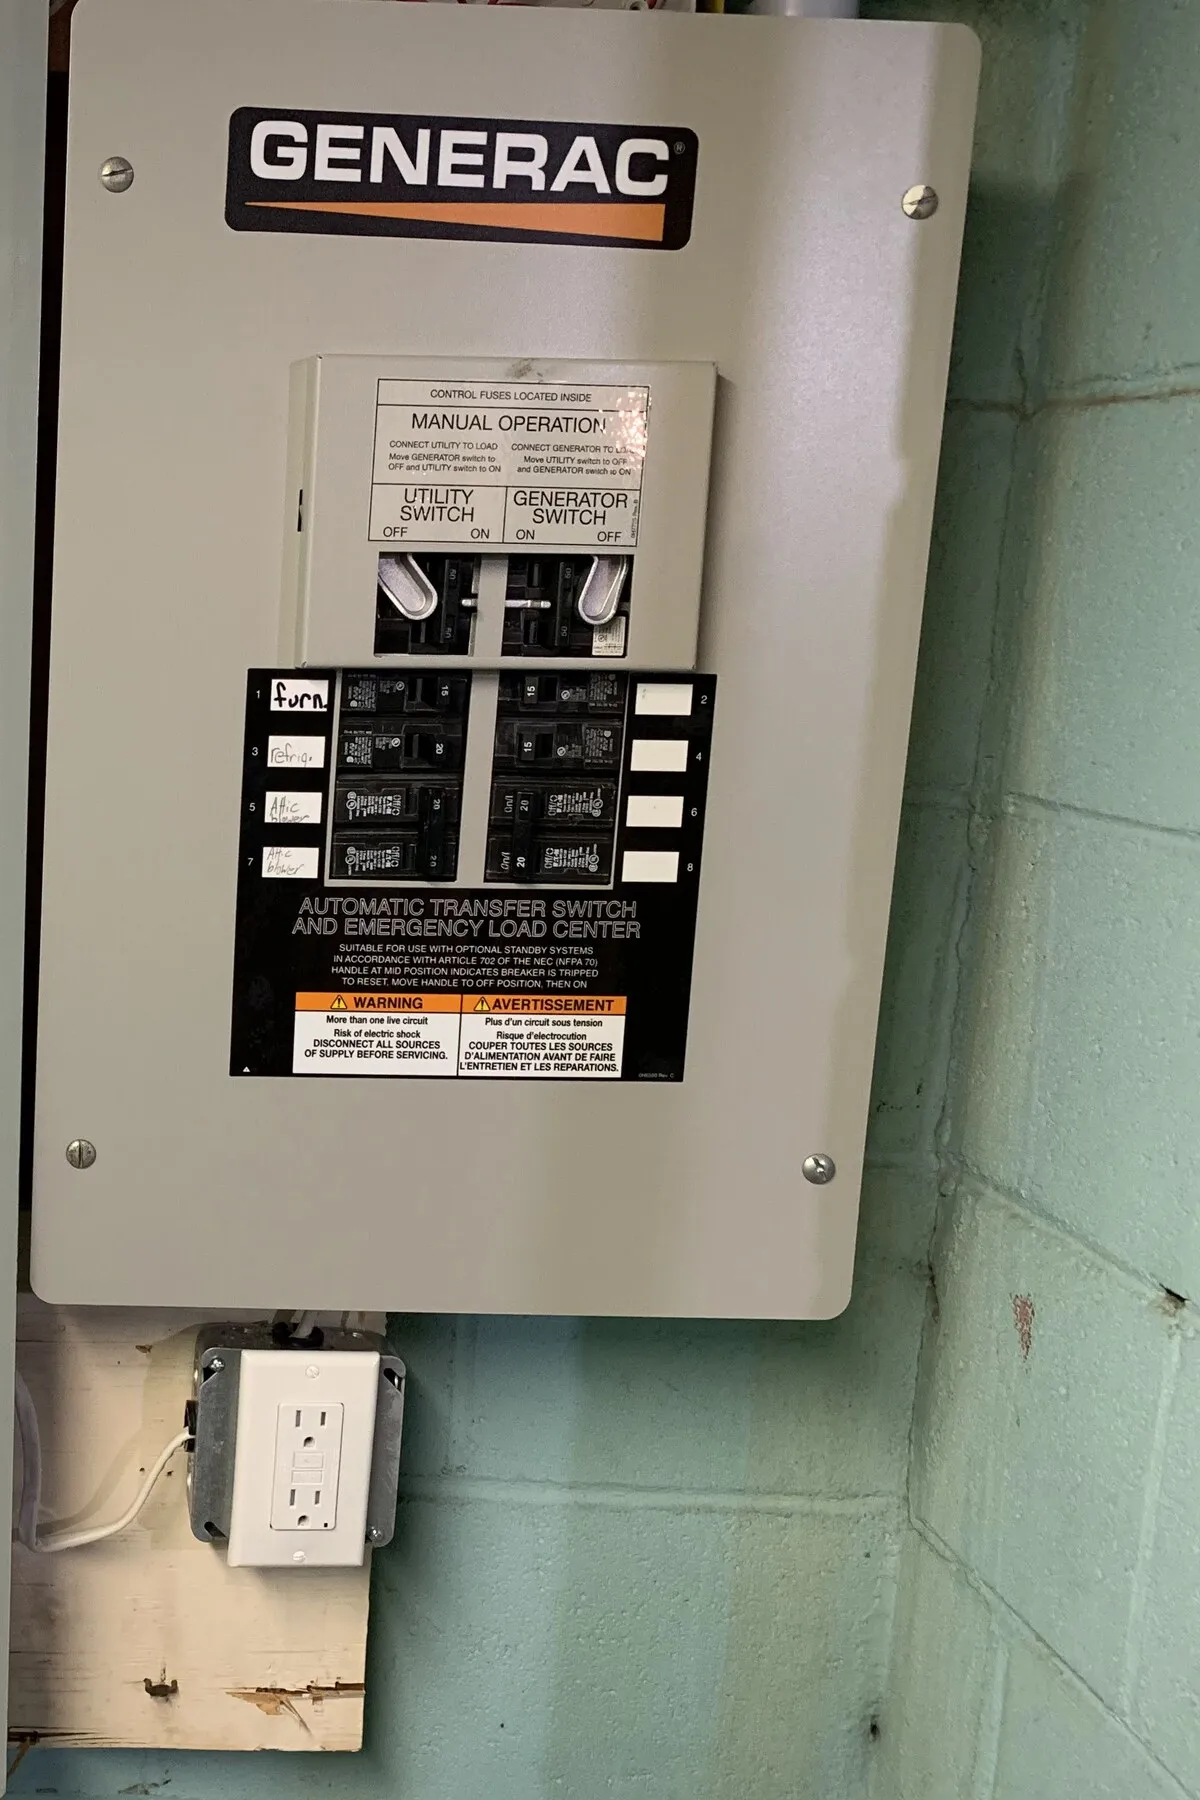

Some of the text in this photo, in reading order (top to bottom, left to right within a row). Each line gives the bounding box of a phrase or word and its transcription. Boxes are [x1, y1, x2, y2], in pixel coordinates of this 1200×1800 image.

[250, 120, 669, 196] GENERAC
[431, 390, 592, 402] CONTROL FUSES LOCATED INSIDE
[412, 413, 606, 434] MANUAL OPERATION
[390, 441, 429, 449] CONNECT
[476, 442, 498, 450] LOAD
[411, 454, 460, 462] GENERATOR
[524, 456, 544, 464] Move
[388, 463, 404, 471] OFF
[406, 463, 420, 471] and
[453, 464, 476, 472] switch
[533, 466, 583, 474] GENERATOR
[585, 467, 608, 475] switch
[404, 488, 473, 505] UTILITY
[514, 491, 628, 508] GENERATOR
[400, 506, 474, 522] SWITCH
[532, 509, 606, 525] SWITCH
[383, 527, 408, 537] OFF
[471, 529, 489, 539] ON
[516, 530, 535, 540] ON
[597, 532, 621, 542] OFF
[441, 686, 448, 696] 15
[527, 686, 535, 697] 15
[701, 696, 707, 704] 2
[252, 747, 258, 755] 3
[436, 744, 443, 754] 20
[524, 742, 532, 752] 15
[249, 803, 255, 811] 5
[521, 800, 529, 811] 20
[691, 808, 697, 816] 6
[248, 858, 254, 866] 7
[517, 857, 525, 868] 20
[299, 898, 636, 918] AUTOMATIC TRANSFER SWITCH
[292, 918, 641, 939] AND EMERGENCY LOAD CENTER
[339, 944, 383, 952] SUITABLE
[455, 946, 502, 954] OPTIONAL
[504, 946, 547, 955] STANDBY
[549, 947, 593, 955] SYSTEMS
[334, 955, 342, 963] IN
[345, 955, 410, 964] ACCORDANCE
[439, 957, 477, 965] ARTICLE
[512, 958, 530, 966] THE
[533, 958, 552, 966] NEC
[555, 958, 582, 967] (NFPA
[584, 959, 598, 968] 70)
[354, 997, 423, 1009] WARNING
[492, 999, 614, 1011] AVERTISSEMENT
[326, 1016, 348, 1024] More
[350, 1016, 367, 1024] than
[386, 1016, 400, 1024] live
[402, 1017, 428, 1025] circuit
[485, 1018, 502, 1026] Plus
[504, 1018, 522, 1026] d'un
[334, 1029, 351, 1037] Risk
[364, 1030, 394, 1038] electric
[397, 1030, 420, 1038] shock
[497, 1032, 587, 1040] Risque d'electrocution
[313, 1039, 374, 1048] DISCONNECT
[396, 1041, 440, 1049] SOURCES
[469, 1042, 612, 1051] COUPER TOUTES LES SOURCES
[305, 1049, 448, 1059] OF SUPPLY BEFORE SERVICING.
[465, 1053, 540, 1061] D'ALIMENTATION
[543, 1053, 573, 1061] AVANT
[575, 1053, 587, 1061] DE
[460, 1063, 618, 1072] L'ENTRETIEN ET LES REPARATIONS.
